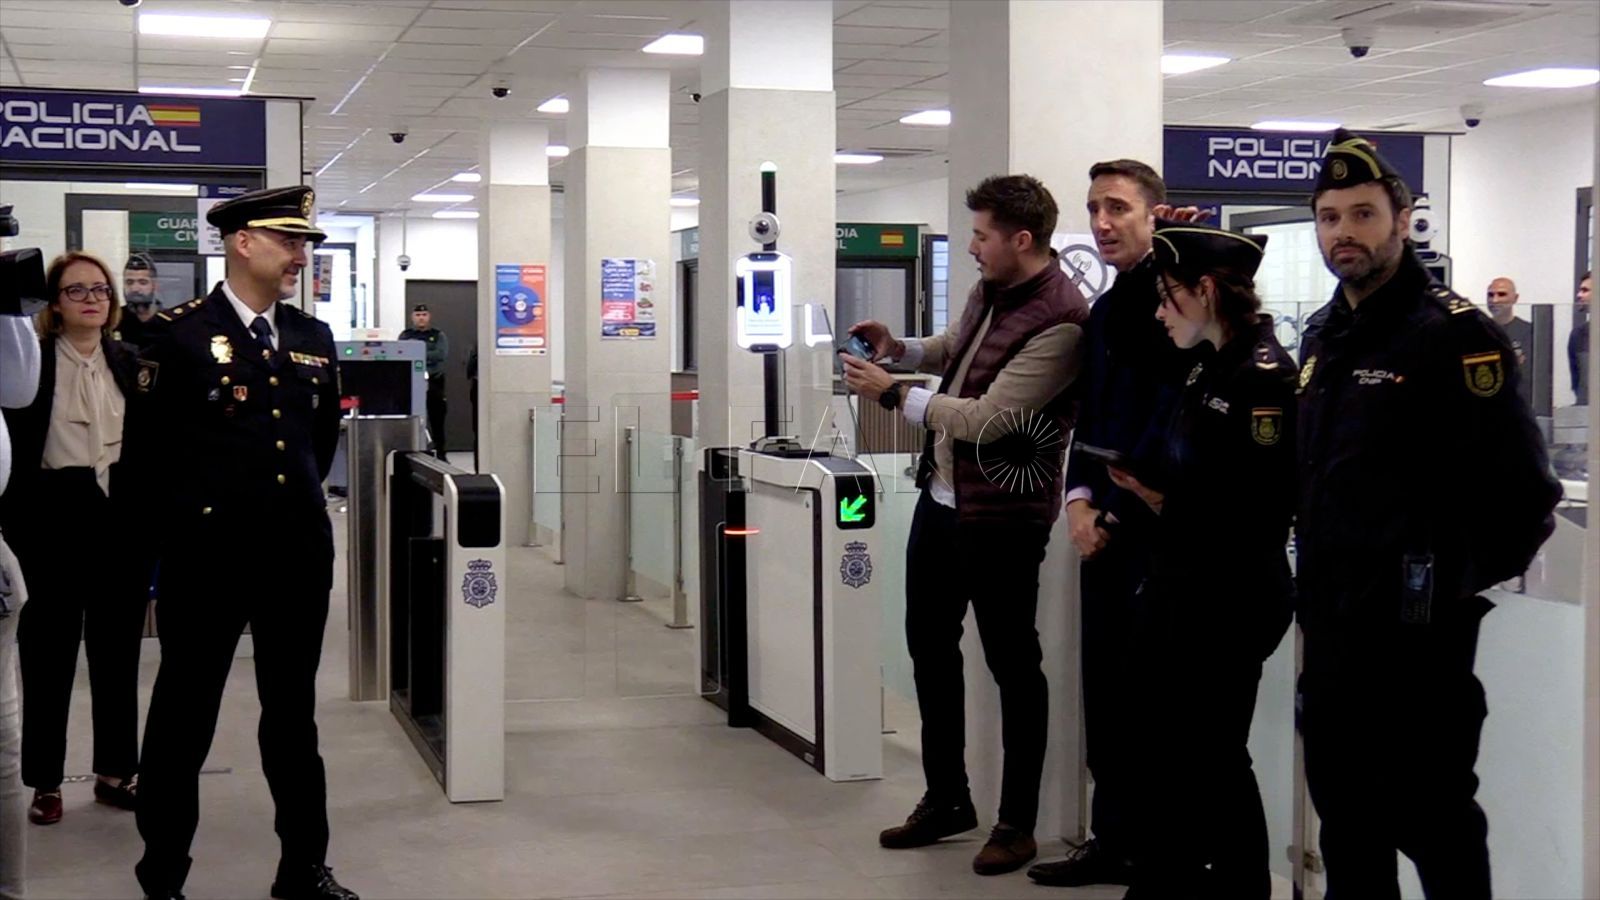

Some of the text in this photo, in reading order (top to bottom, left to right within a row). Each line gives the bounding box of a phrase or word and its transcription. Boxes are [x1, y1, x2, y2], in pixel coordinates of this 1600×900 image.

[0, 100, 154, 126] OLICÍA
[0, 126, 201, 152] ACIONAL
[1208, 159, 1322, 180] NACION
[157, 218, 198, 229] GUAR
[175, 231, 198, 241] CIV
[836, 228, 858, 239] DIA
